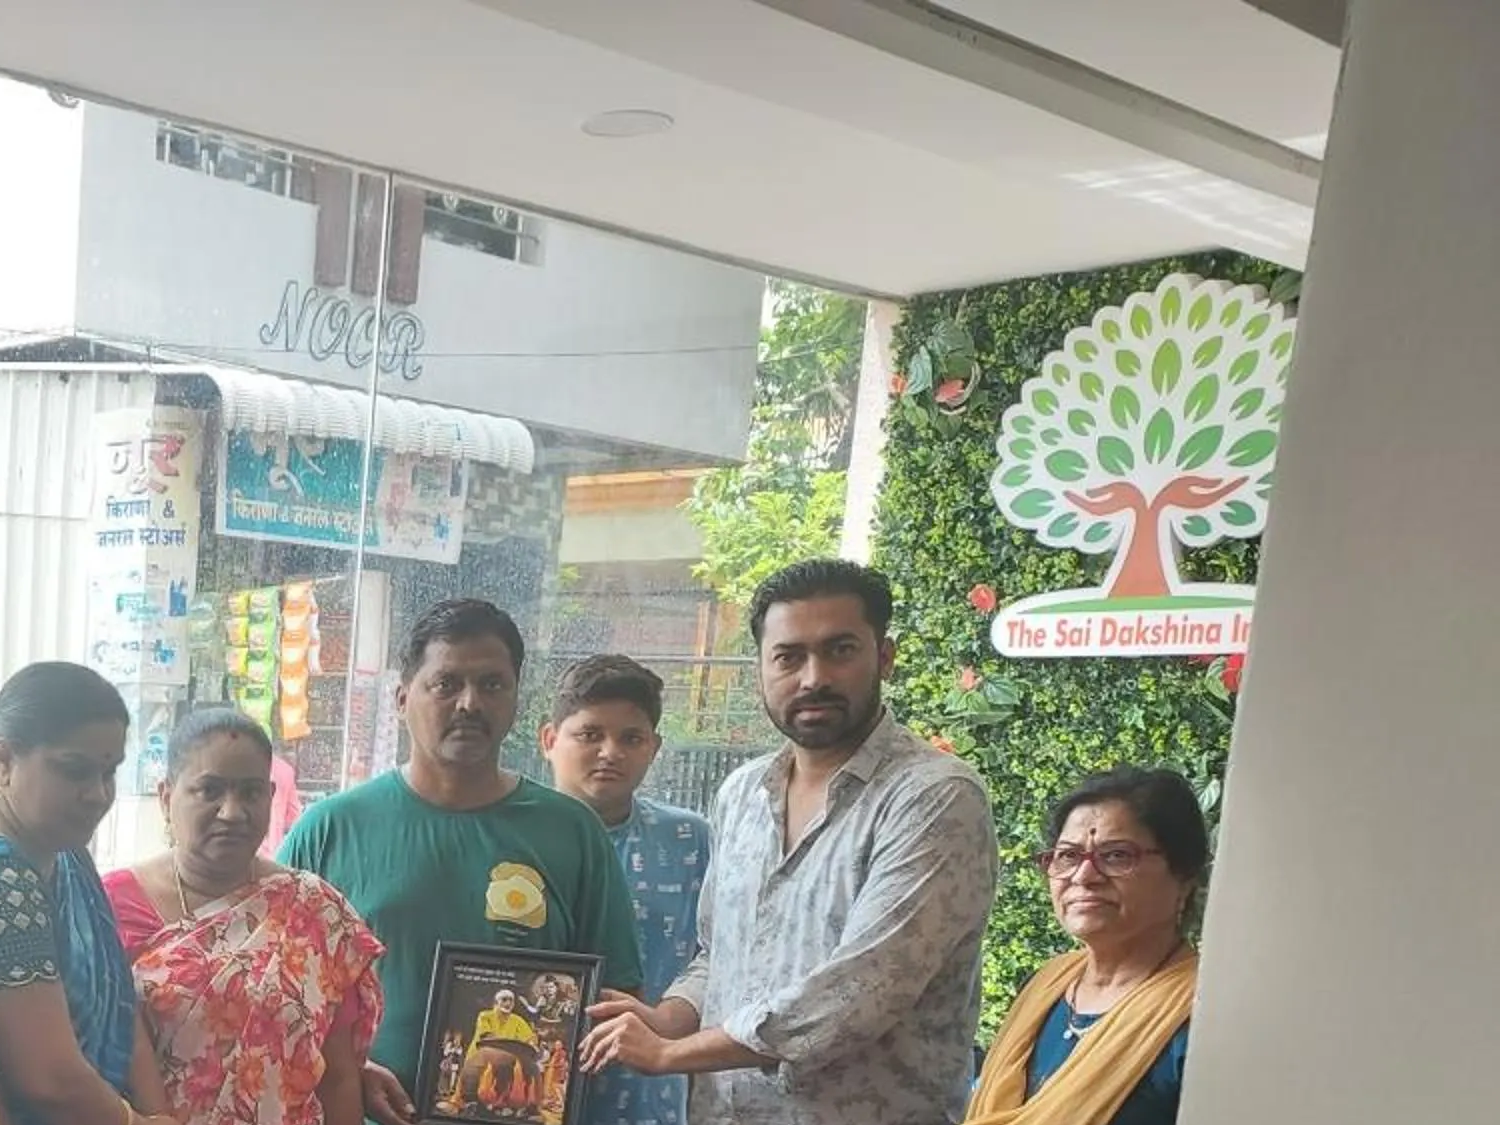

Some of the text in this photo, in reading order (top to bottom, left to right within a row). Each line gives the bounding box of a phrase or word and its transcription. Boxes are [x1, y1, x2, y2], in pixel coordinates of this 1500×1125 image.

[259, 279, 425, 381] NOOR
[162, 499, 175, 519] &
[1007, 619, 1047, 648] The
[1054, 616, 1091, 647] Sai
[1100, 614, 1222, 647] Dakshina
